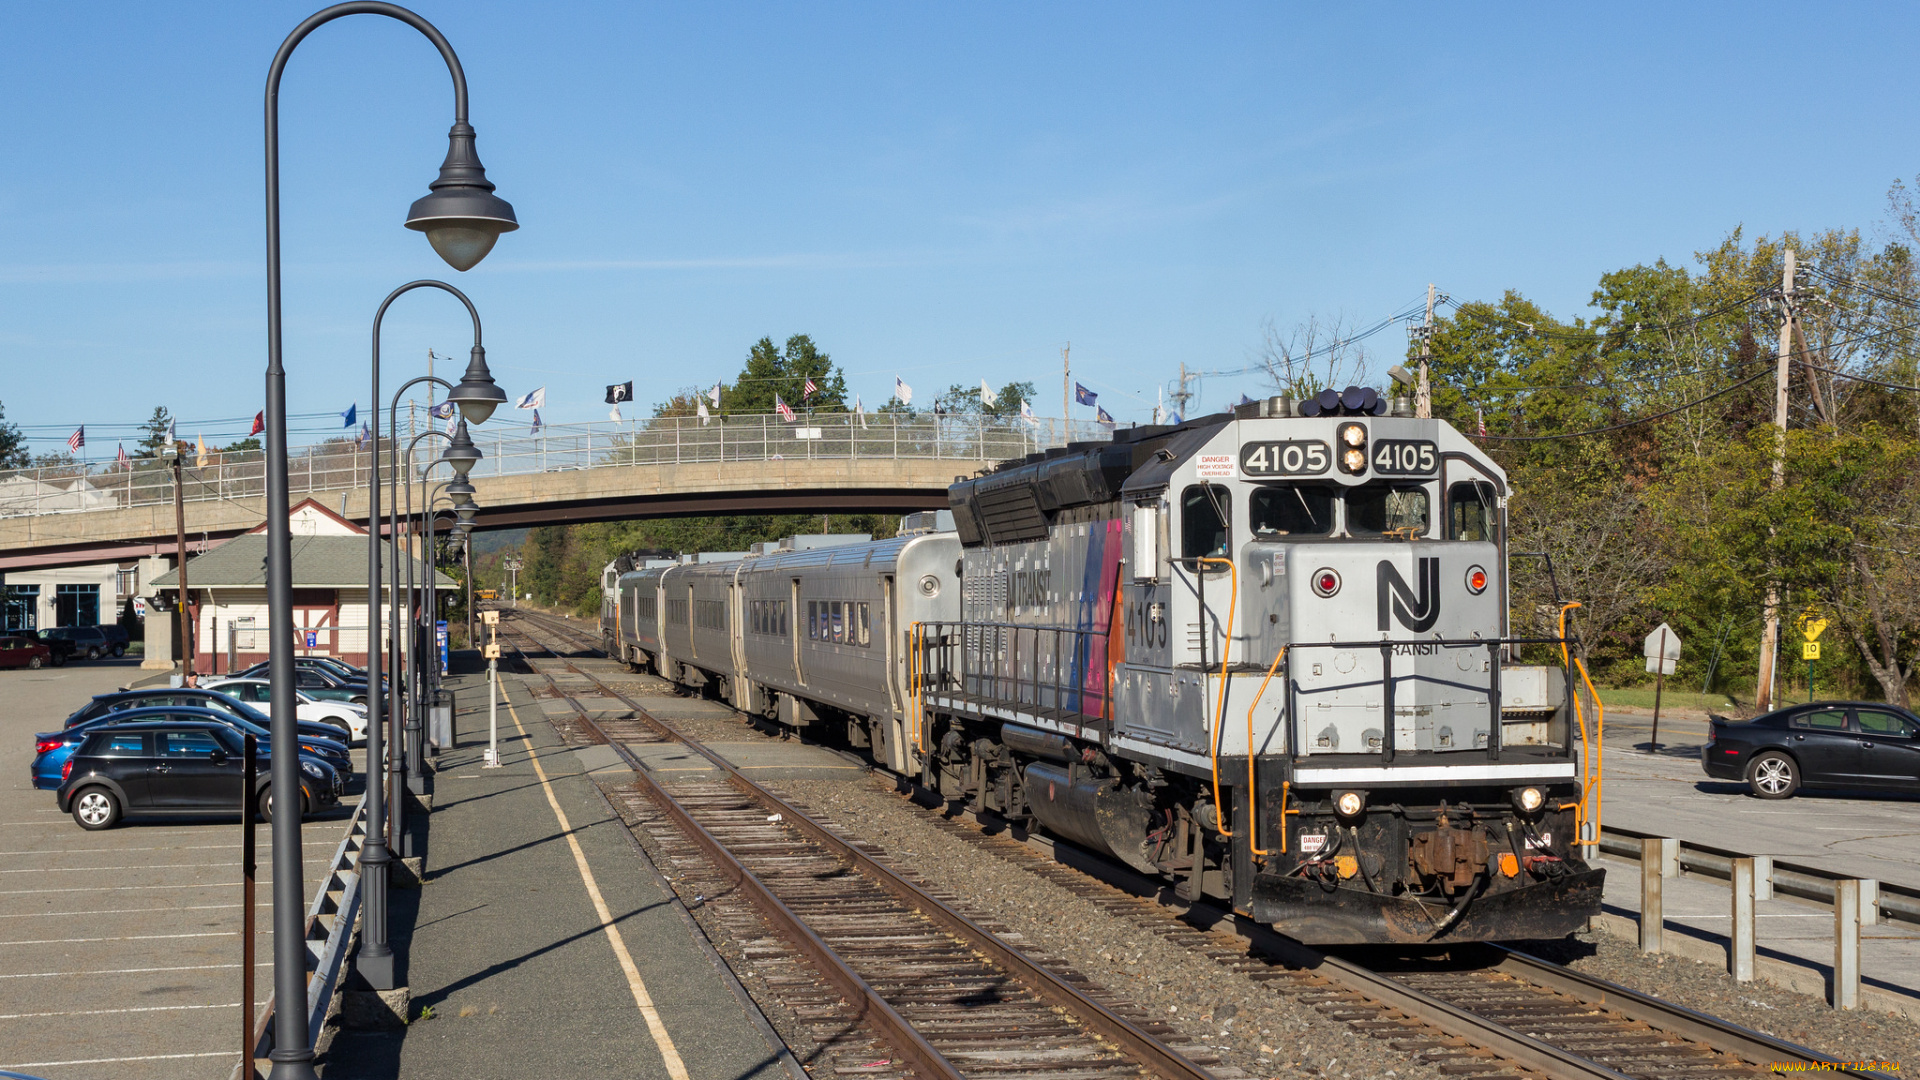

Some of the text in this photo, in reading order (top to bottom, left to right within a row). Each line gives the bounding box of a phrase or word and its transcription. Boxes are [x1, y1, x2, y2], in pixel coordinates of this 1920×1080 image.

[1245, 445, 1327, 472] 4105
[1375, 444, 1435, 471] 4105
[1376, 557, 1441, 634] NJ
[1127, 601, 1167, 649] 4105
[1389, 643, 1438, 656] RANSIT
[1805, 644, 1817, 653] 10
